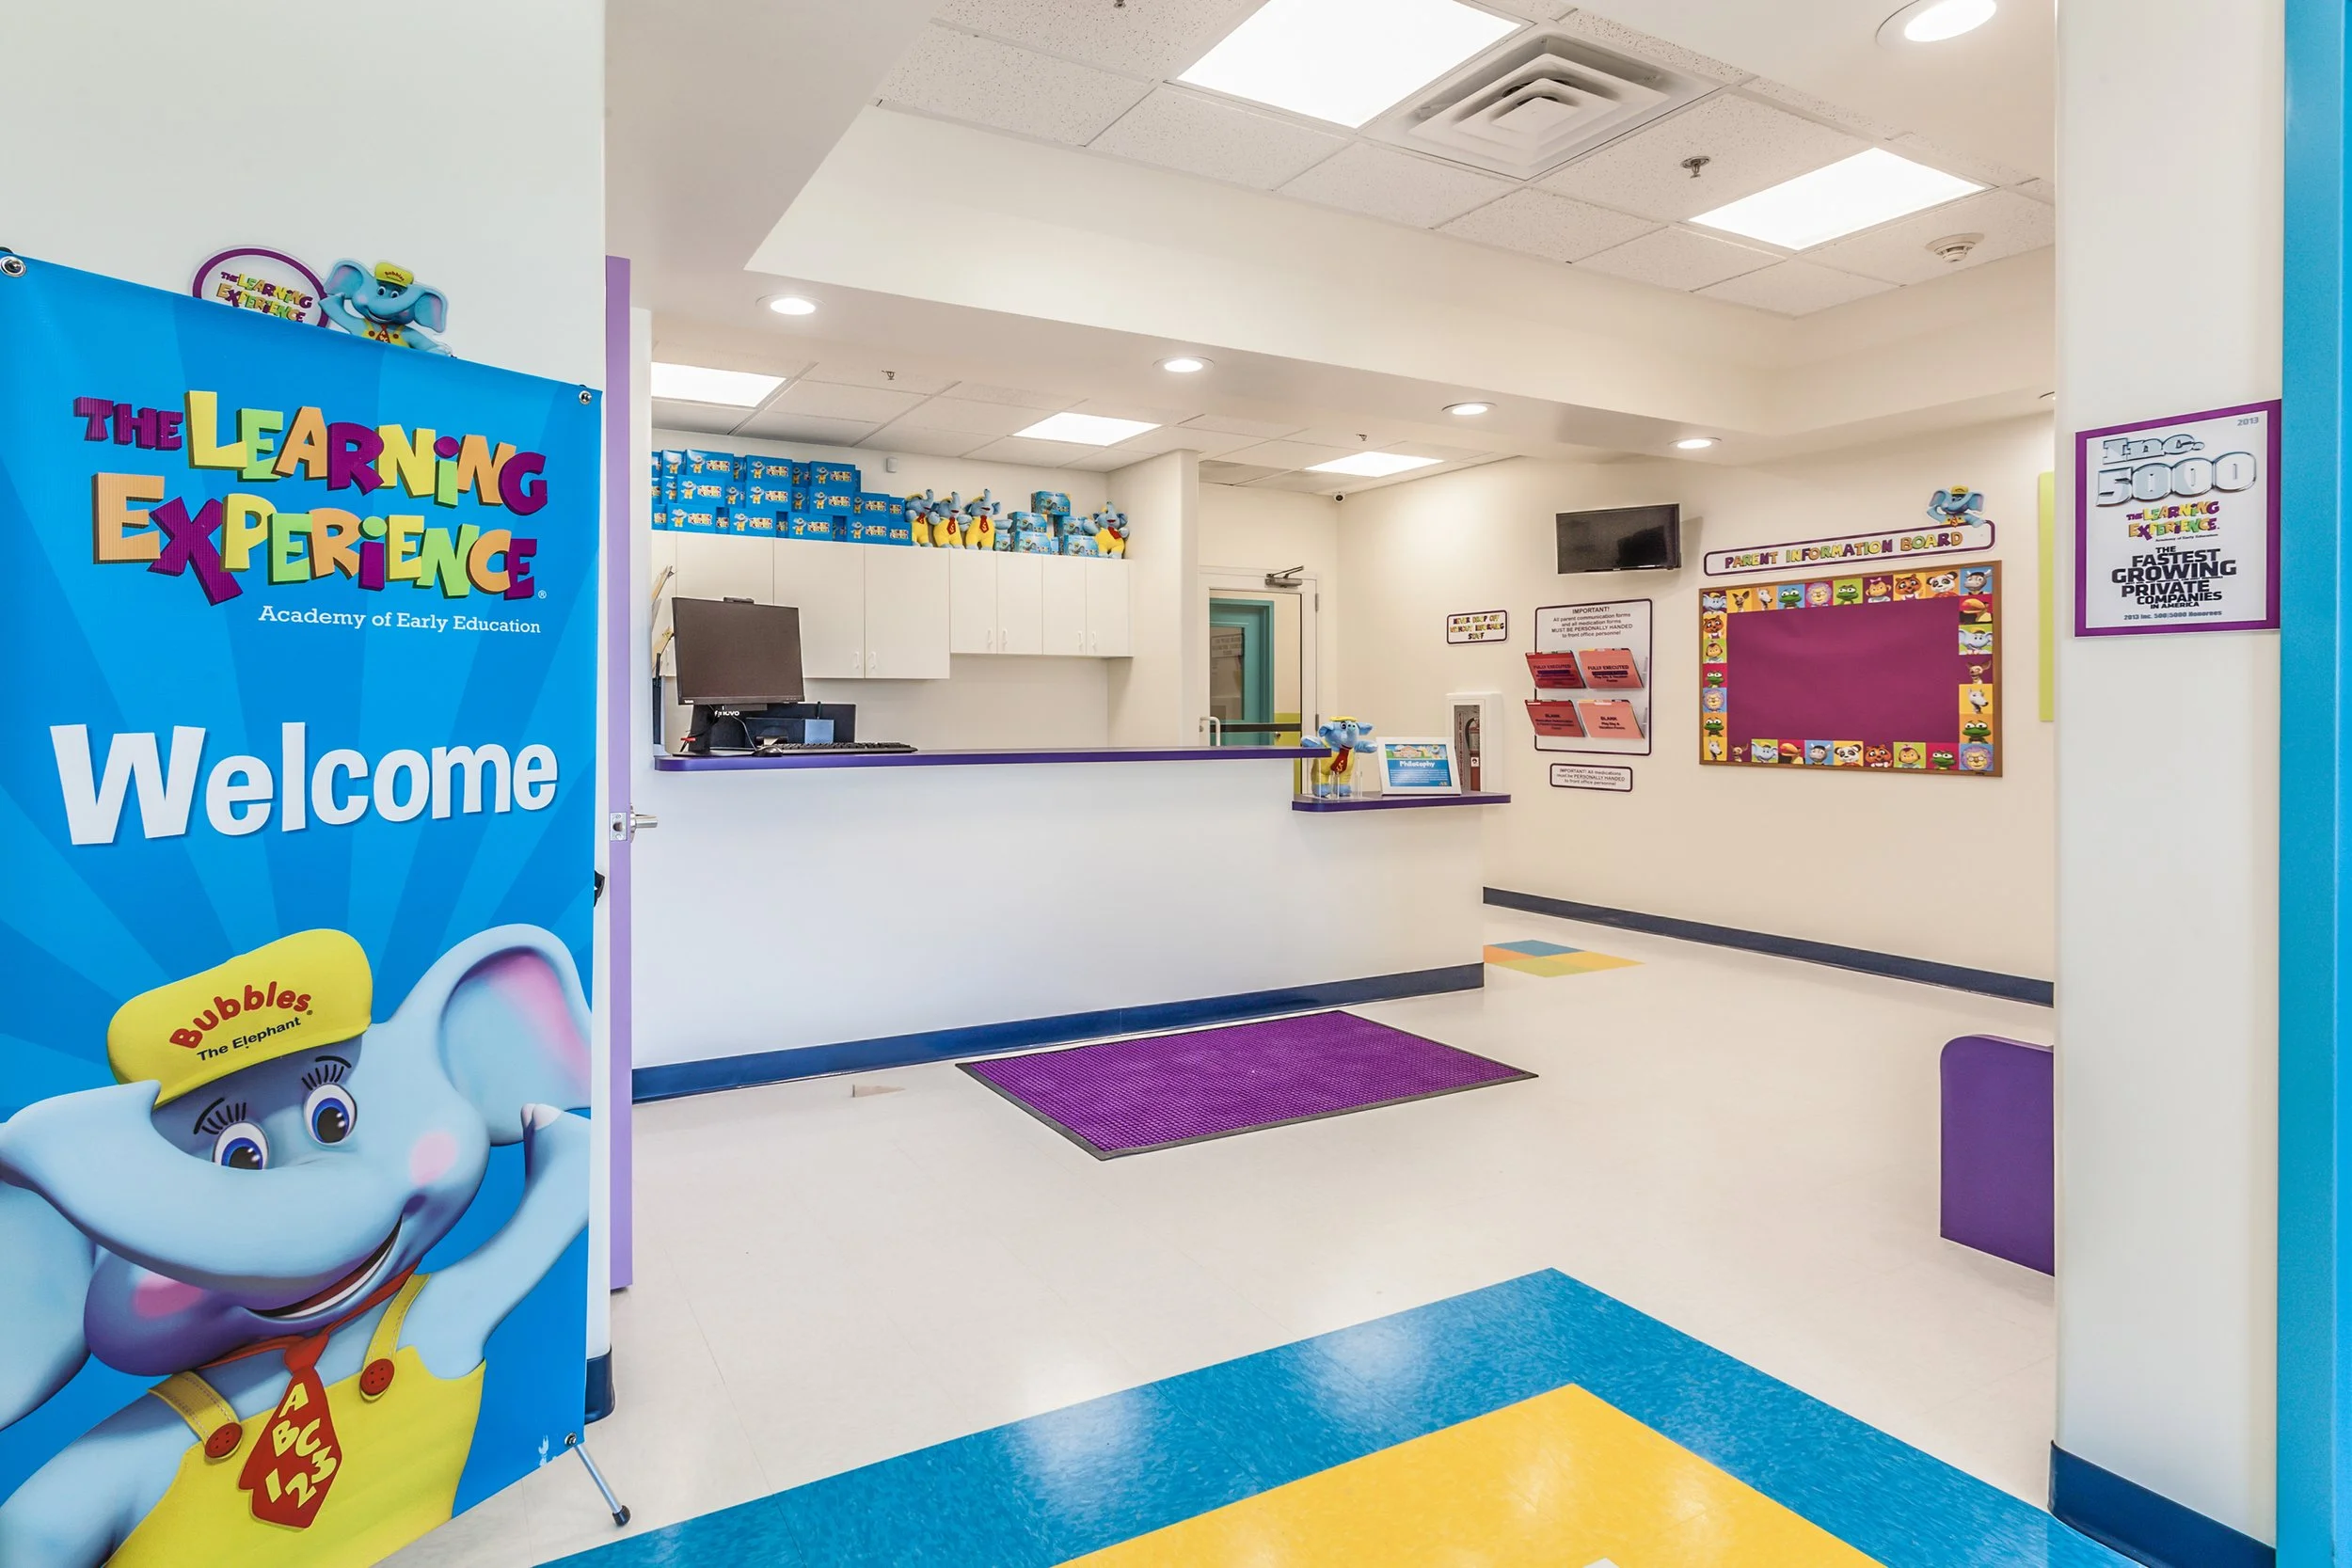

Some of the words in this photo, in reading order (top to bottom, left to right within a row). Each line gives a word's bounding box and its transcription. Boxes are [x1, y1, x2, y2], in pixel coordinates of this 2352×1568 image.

[220, 272, 239, 282] THE
[73, 396, 183, 451] THE
[2237, 417, 2259, 426] 2013
[2103, 434, 2205, 465] Inc.
[2096, 451, 2257, 507] 5000
[1724, 551, 1778, 569] PARENT
[1786, 539, 1893, 562] INFORMATION
[1900, 531, 1963, 552] BOARD
[2132, 548, 2220, 567] FASTEST
[2111, 560, 2237, 584] GROWING
[2122, 580, 2210, 597] PRIVATE
[2137, 592, 2222, 605] COMPANIES
[258, 605, 366, 628] Academy
[372, 610, 392, 627] of
[397, 612, 448, 633] Early
[453, 615, 542, 634] Education
[49, 721, 559, 846] Welcome
[169, 980, 312, 1049] Bubbles
[197, 1041, 229, 1062] The
[231, 1017, 301, 1050] Elephant
[278, 1383, 309, 1418] A
